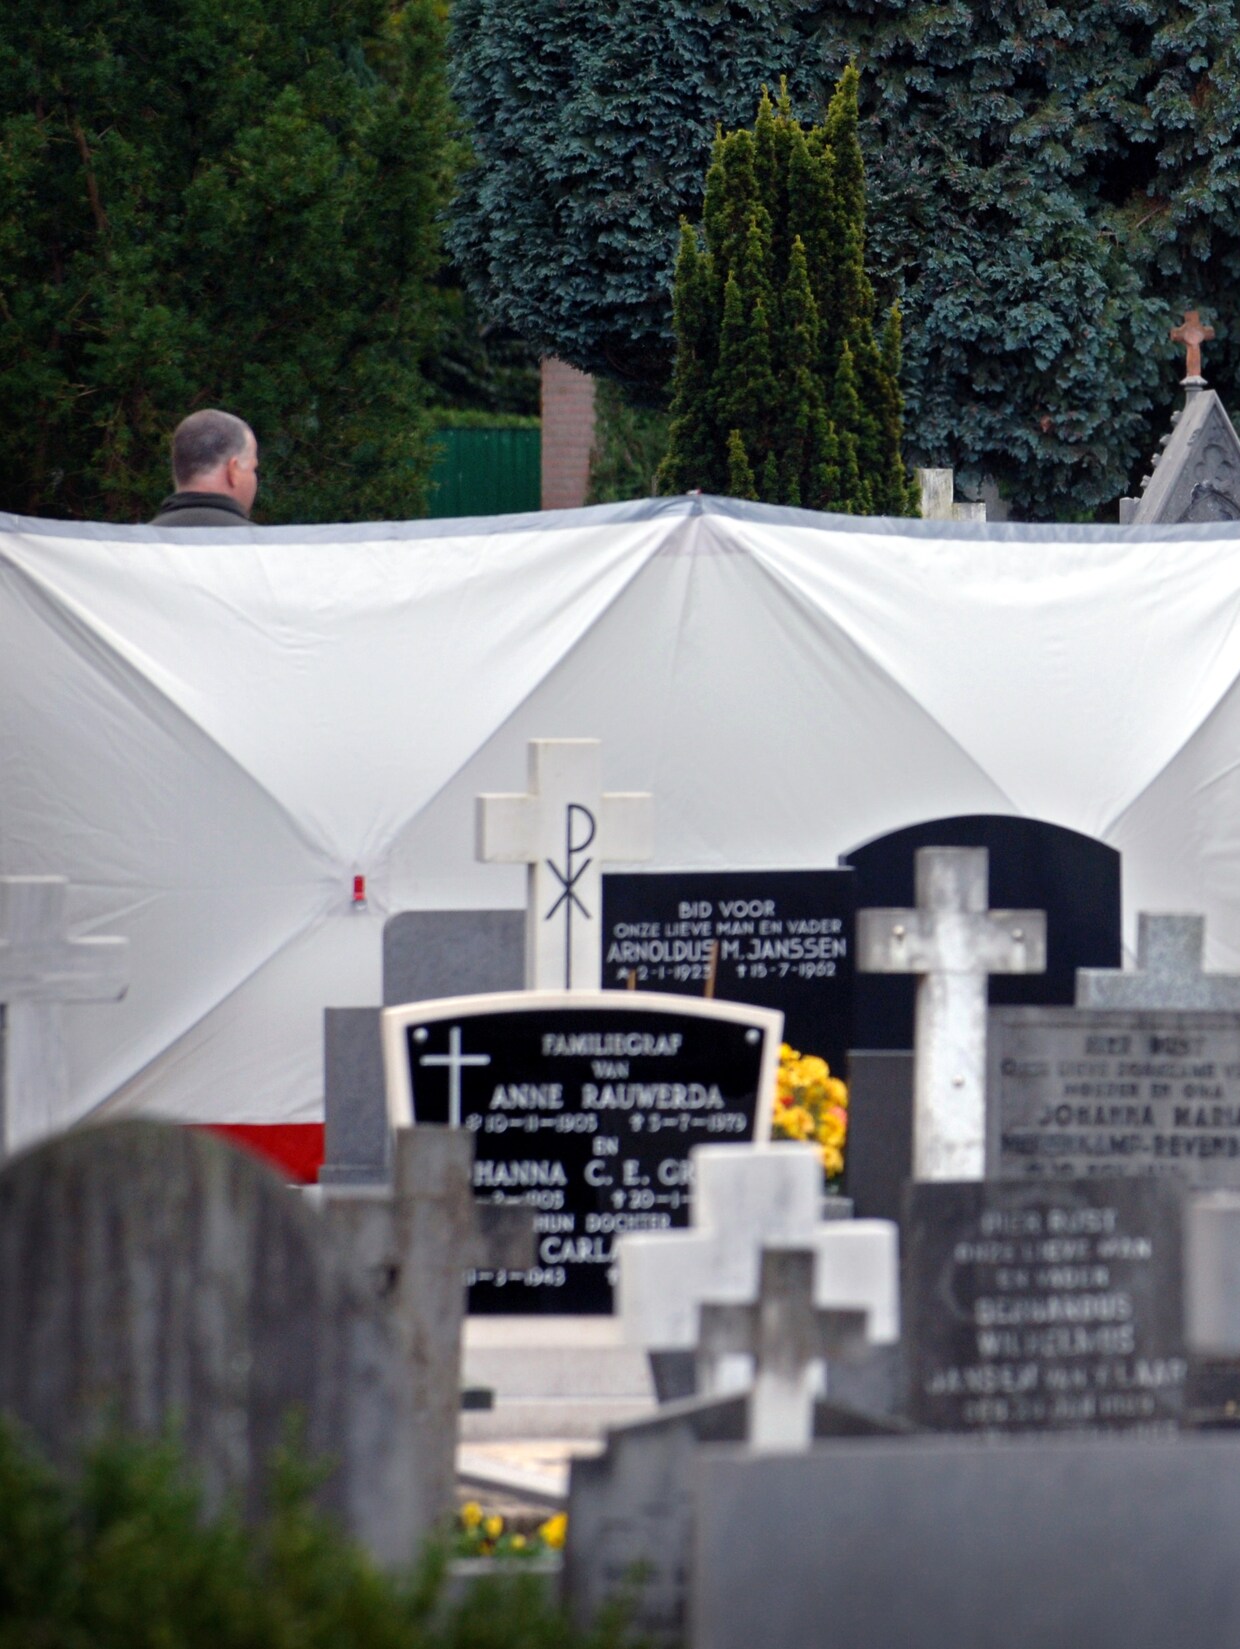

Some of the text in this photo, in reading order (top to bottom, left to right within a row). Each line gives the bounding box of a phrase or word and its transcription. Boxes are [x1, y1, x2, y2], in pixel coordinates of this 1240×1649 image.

[678, 899, 776, 919] BID VOOR
[613, 918, 842, 939] ONZE LIEVE MAN EN VADER
[606, 939, 714, 963] ARNOLDUS
[541, 1032, 683, 1056] FAMILIEGRAF
[590, 1059, 630, 1080] VAN
[488, 1083, 725, 1110] ANNE RAUWERDA
[592, 1136, 620, 1156] EN
[583, 1158, 614, 1187] C.
[621, 1159, 651, 1187] E.
[533, 1212, 671, 1234] HUN DOCHTER
